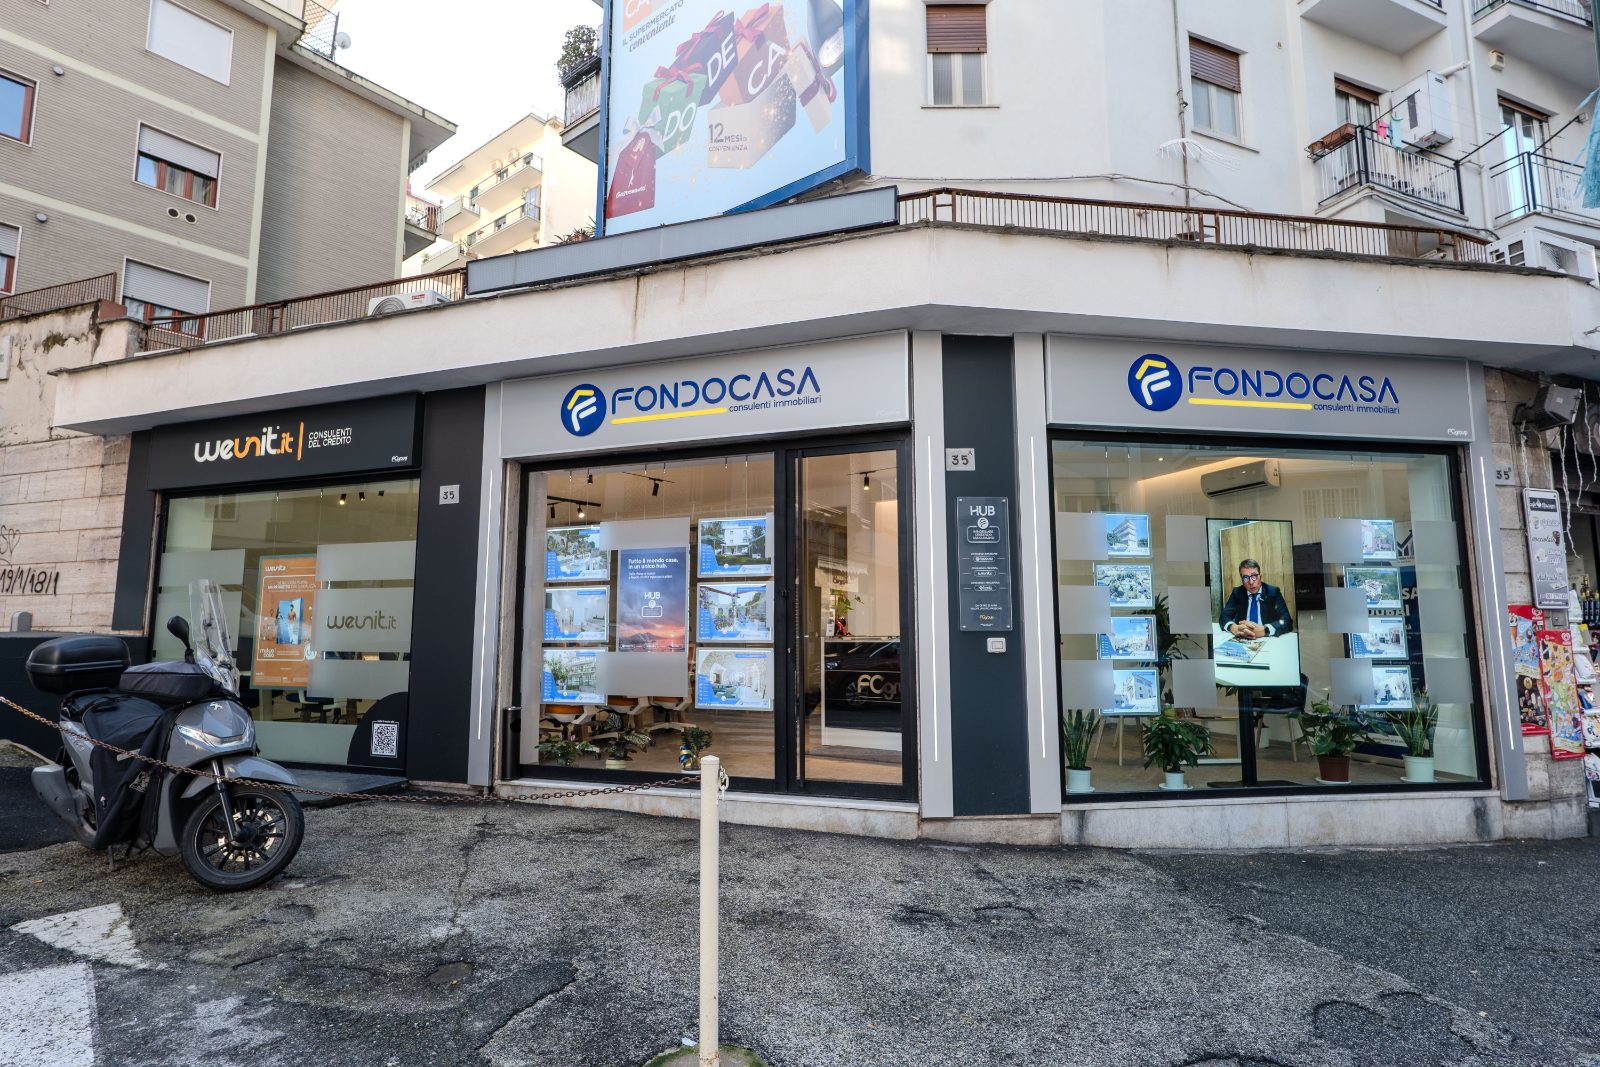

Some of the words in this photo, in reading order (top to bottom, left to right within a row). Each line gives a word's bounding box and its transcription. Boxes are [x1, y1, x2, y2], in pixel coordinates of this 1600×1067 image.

[629, 0, 684, 42] SUPERMERCATO
[629, 14, 676, 53] conveniente
[661, 102, 697, 142] DO
[707, 31, 736, 88] DE
[747, 42, 786, 96] CA
[708, 122, 724, 143] 12
[611, 366, 821, 415] FONDOCASA
[1187, 366, 1399, 404] FONDOCASA
[728, 398, 771, 413] consulenti
[773, 394, 822, 408] immobiliari
[1313, 402, 1355, 412] consulenti
[1356, 404, 1400, 415] immobiliari
[308, 427, 353, 441] CONSULENTI
[308, 439, 321, 448] DEL
[322, 436, 352, 447] CREDITO
[443, 490, 455, 500] 35
[969, 505, 996, 516] HUB
[644, 592, 661, 600] HUB
[326, 610, 397, 630] weunit.it
